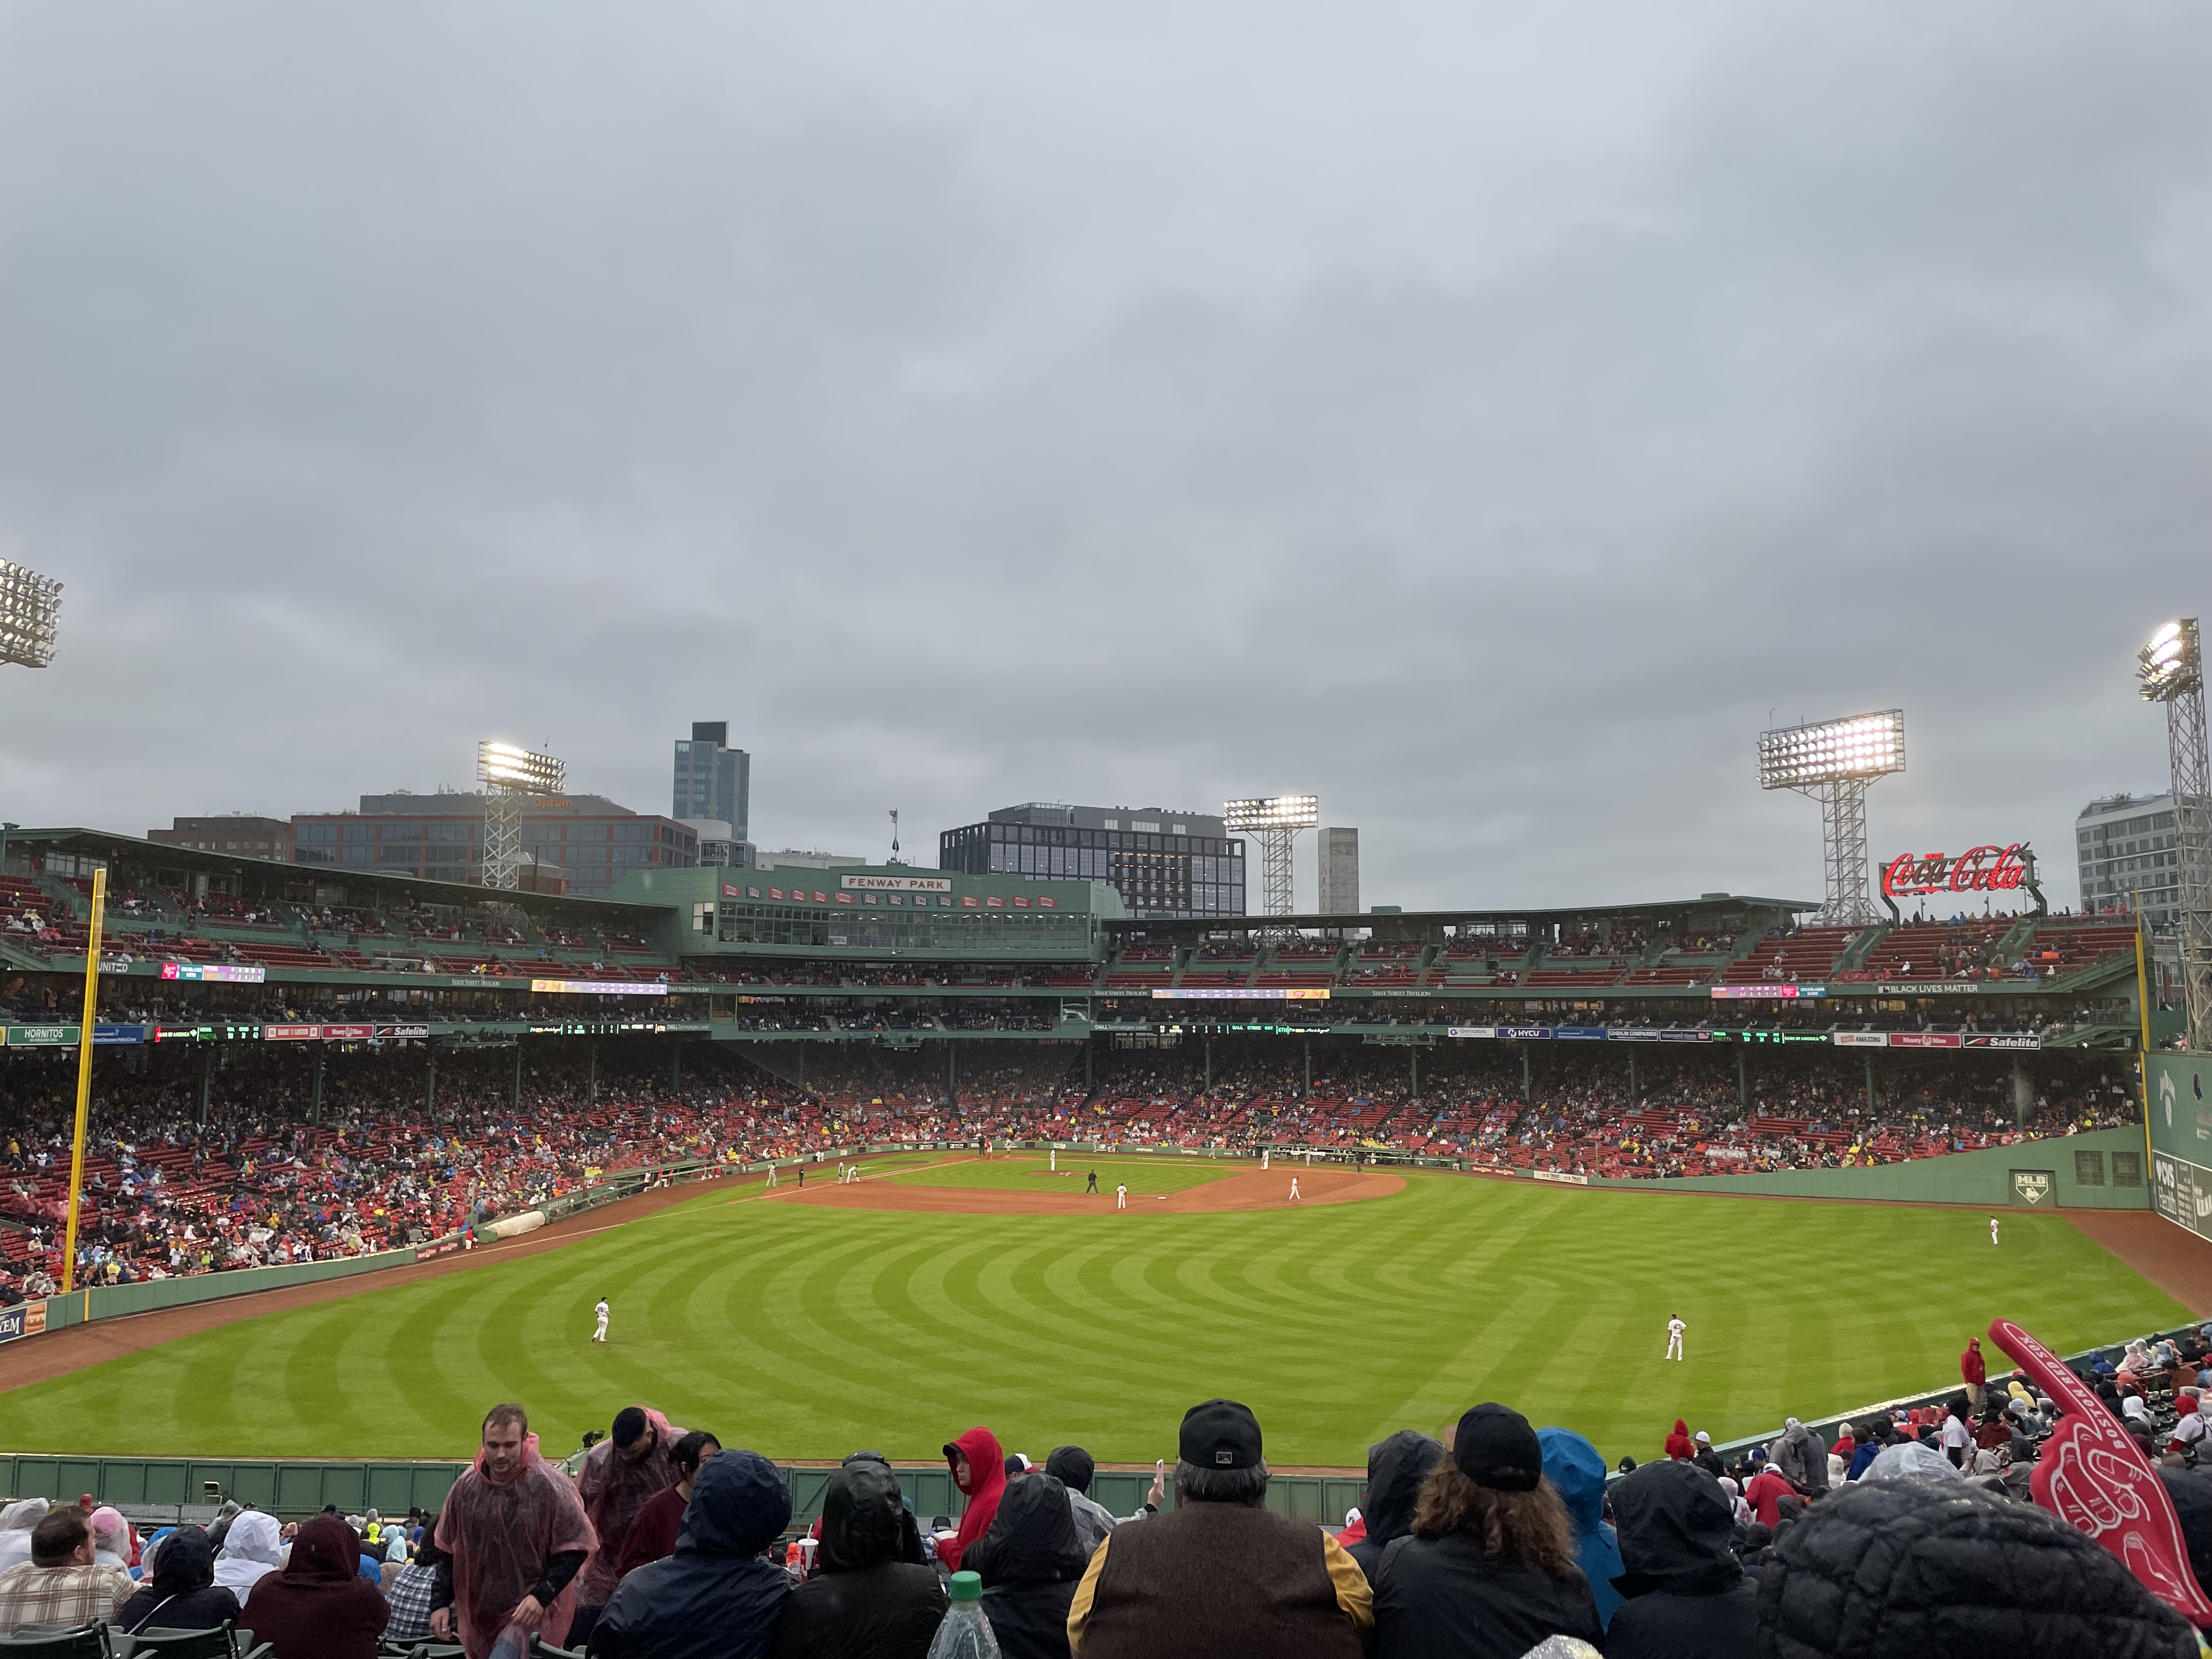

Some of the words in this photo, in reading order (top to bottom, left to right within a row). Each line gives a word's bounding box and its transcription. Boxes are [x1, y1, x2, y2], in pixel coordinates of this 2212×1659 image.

[532, 798, 573, 809] Optum
[1883, 842, 2030, 896] Coca-Cola
[849, 878, 901, 888] FENWAY
[910, 880, 944, 889] PARK
[97, 962, 128, 973] UNITED
[25, 1029, 63, 1038] HORNITOS
[394, 1026, 426, 1036] Safelite
[1990, 1037, 2038, 1047] Safelite
[2017, 1175, 2046, 1184] MLB
[2162, 1161, 2175, 1188] CVS
[2019, 1334, 2050, 1359] SOX
[2047, 1359, 2075, 1386] RED
[2074, 1388, 2127, 1450] BOSTON
